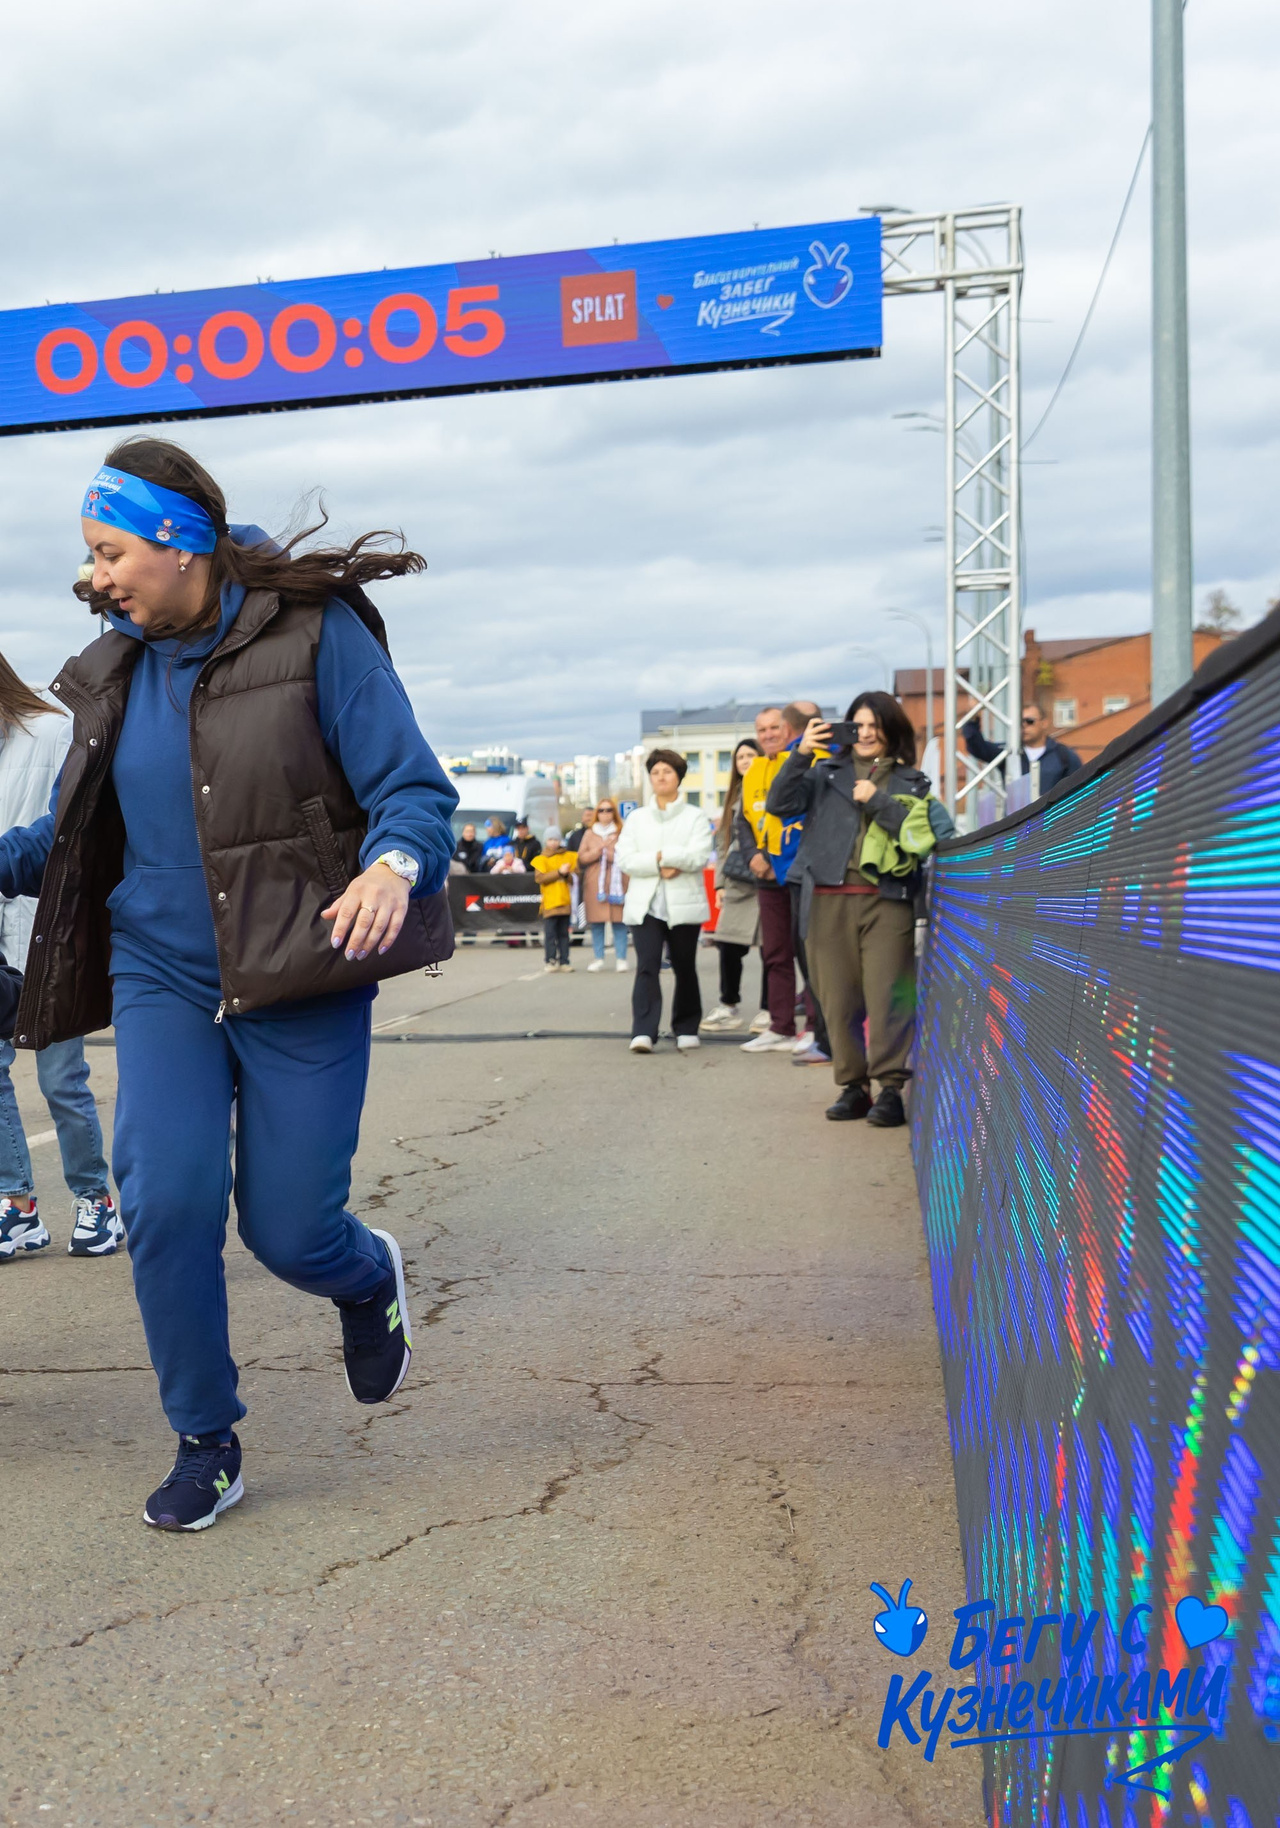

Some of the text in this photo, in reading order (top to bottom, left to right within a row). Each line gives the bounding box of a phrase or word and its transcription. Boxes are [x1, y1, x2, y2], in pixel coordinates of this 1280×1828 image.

[720, 275, 776, 300] ЗАБЕГ
[571, 293, 626, 325] SPLAT
[696, 291, 798, 330] Кузнечики
[35, 284, 506, 395] 00:00:05
